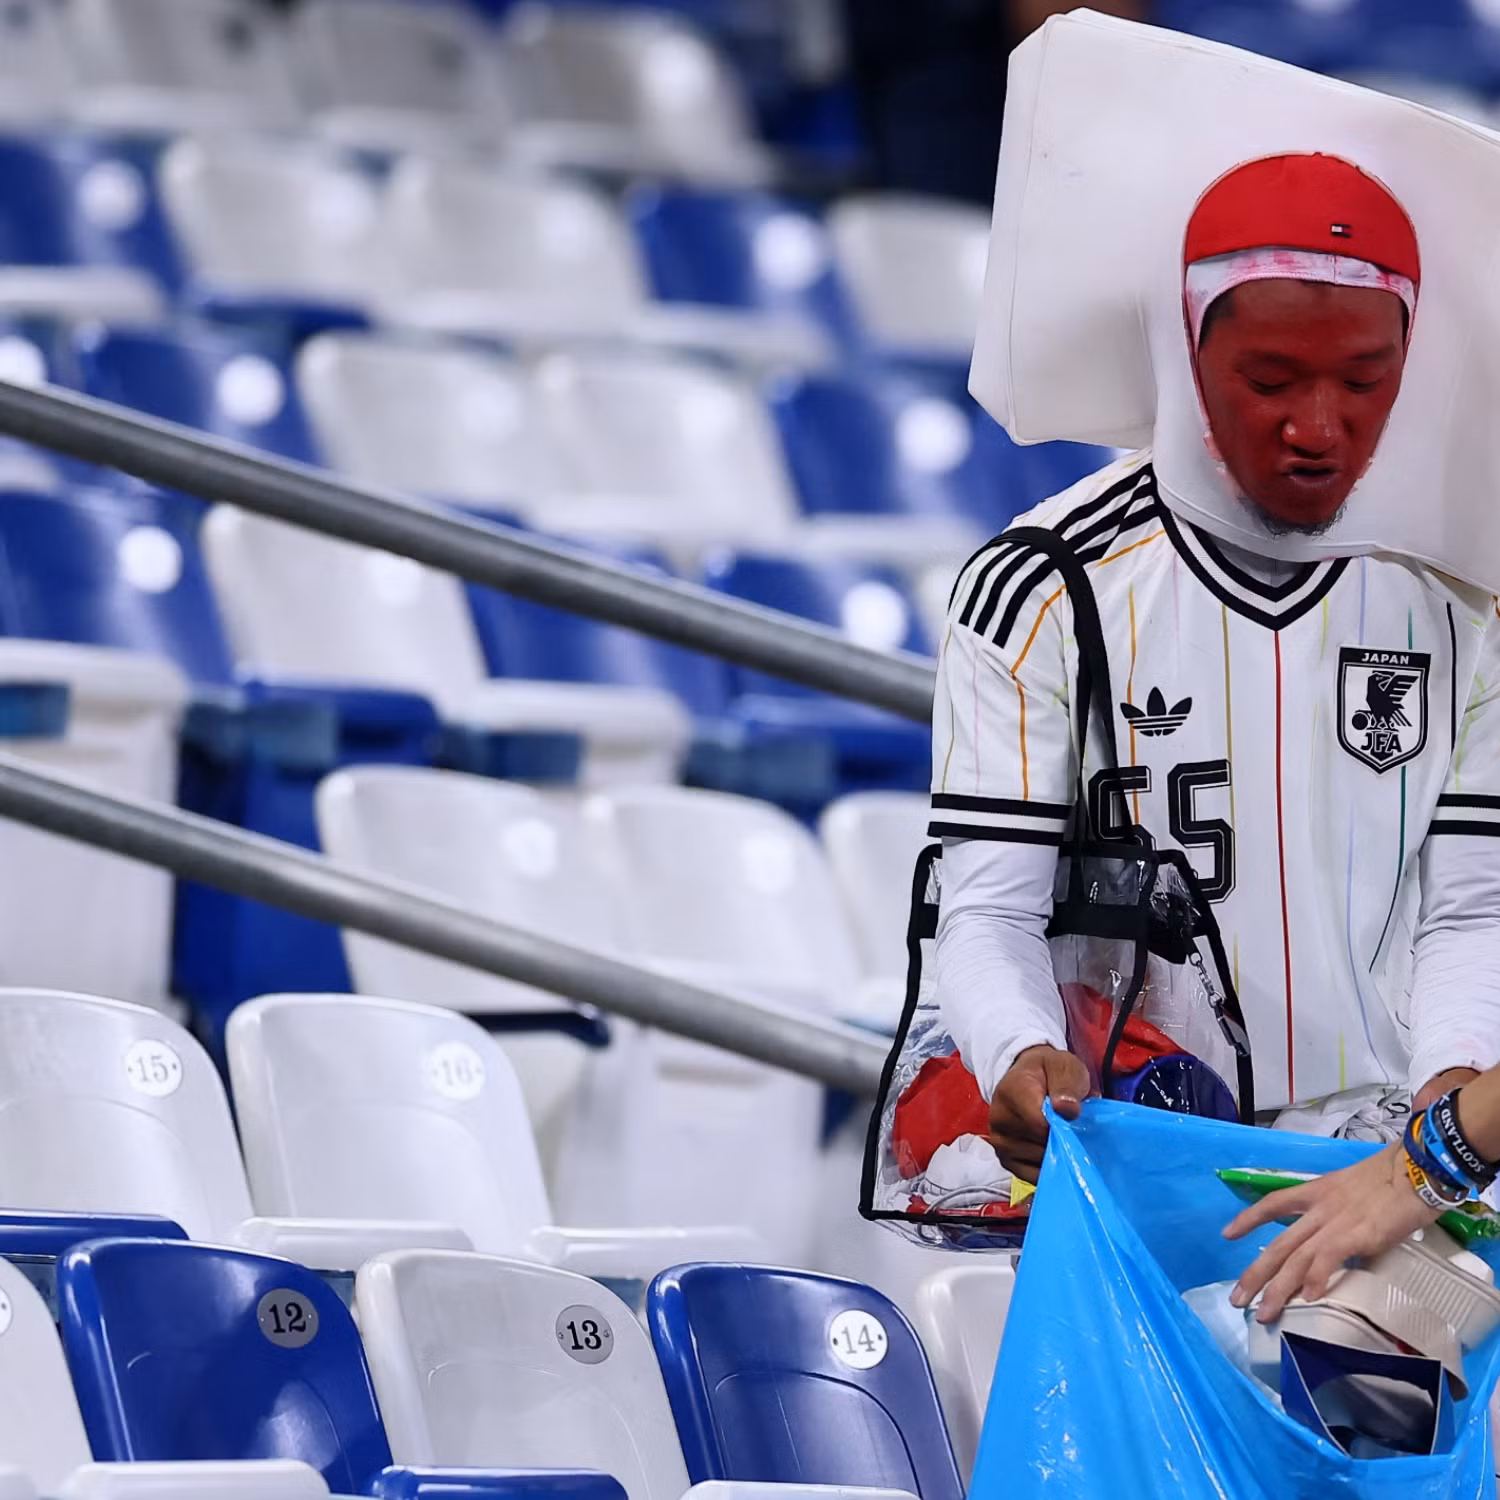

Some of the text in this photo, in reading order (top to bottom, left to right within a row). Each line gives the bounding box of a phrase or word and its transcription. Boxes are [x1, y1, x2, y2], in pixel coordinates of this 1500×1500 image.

[1361, 652, 1410, 665] JAPAN
[1360, 731, 1402, 753] JFA
[1088, 758, 1236, 905] 55
[135, 1055, 169, 1084] 15
[441, 1059, 473, 1086] 16
[1440, 1108, 1485, 1173] SCOTLAND
[269, 1302, 307, 1334] 12
[565, 1318, 602, 1350] 13
[840, 1324, 877, 1354] 14
